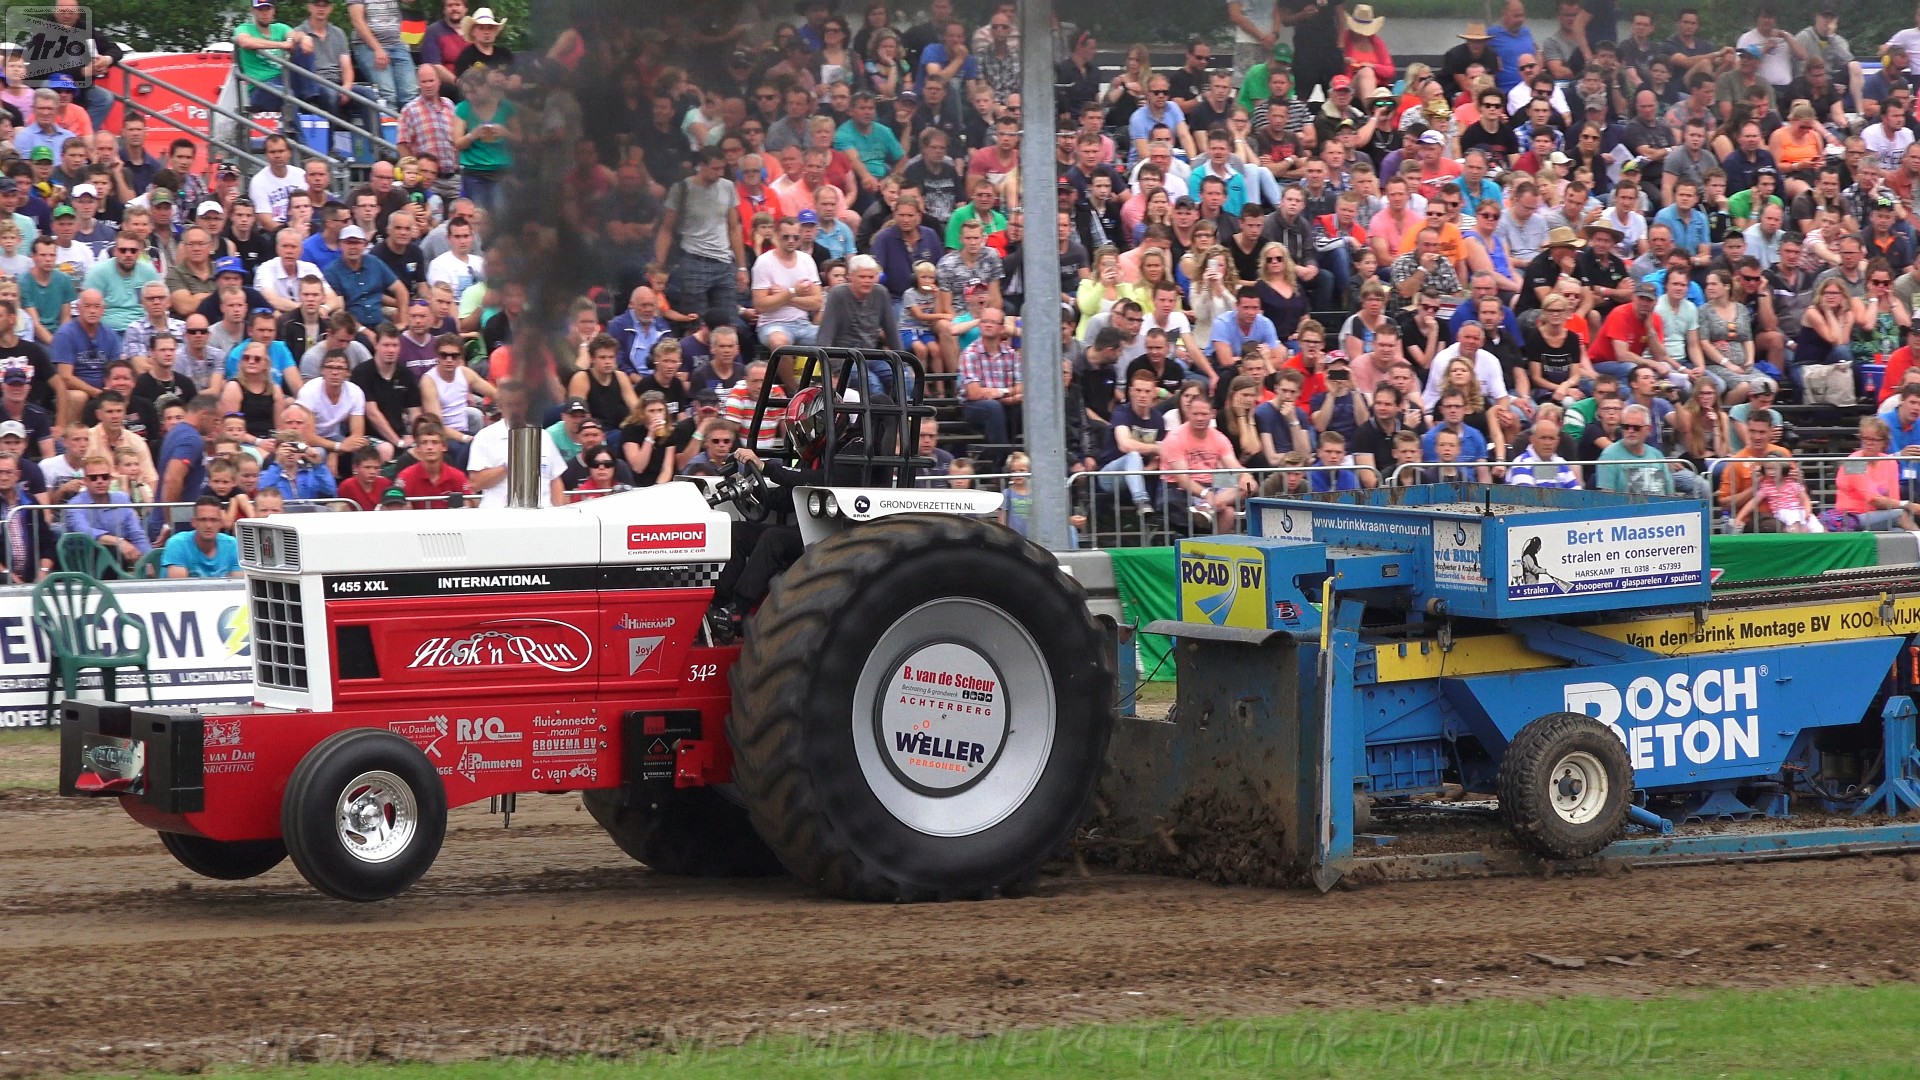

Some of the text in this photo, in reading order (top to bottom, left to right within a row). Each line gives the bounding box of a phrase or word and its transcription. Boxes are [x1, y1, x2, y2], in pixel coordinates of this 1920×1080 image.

[879, 500, 976, 511] GRONDVERZETTEN.NL
[631, 531, 703, 542] CHAMPION
[1567, 524, 1686, 546] Bert Maassen
[1452, 548, 1480, 563] BRIN
[1561, 545, 1695, 565] stralen en conserveren
[1240, 565, 1262, 589] BV
[1575, 568, 1615, 578] HARSKAMP
[1620, 566, 1632, 574] TEL
[1634, 564, 1650, 573] 0318
[1658, 562, 1681, 571] 457393
[331, 580, 389, 593] 1455 XXL
[438, 574, 551, 589] INTERNATIONAL
[1523, 585, 1549, 595] stralen
[1575, 580, 1613, 591] shooperen
[1621, 575, 1662, 588] glasparelen
[1670, 573, 1697, 584] spuiten
[1626, 632, 1654, 649] Van
[1659, 630, 1688, 646] den
[1694, 624, 1735, 644] Brink
[1740, 621, 1806, 640] Montage
[1811, 615, 1831, 632] BV
[406, 637, 484, 669] Hook
[507, 635, 579, 665] Run
[635, 645, 653, 656] Joy!
[687, 663, 717, 682] 342
[903, 665, 996, 693] B. van de Scheur
[900, 695, 992, 717] ACHTERBERG
[408, 724, 436, 734] Daalen
[549, 728, 582, 737] manuli
[532, 737, 597, 751] GROVEMA BV
[895, 731, 985, 764] WELLER
[909, 757, 967, 773] PERSONEEL
[532, 768, 544, 780] C.
[547, 769, 567, 779] van
